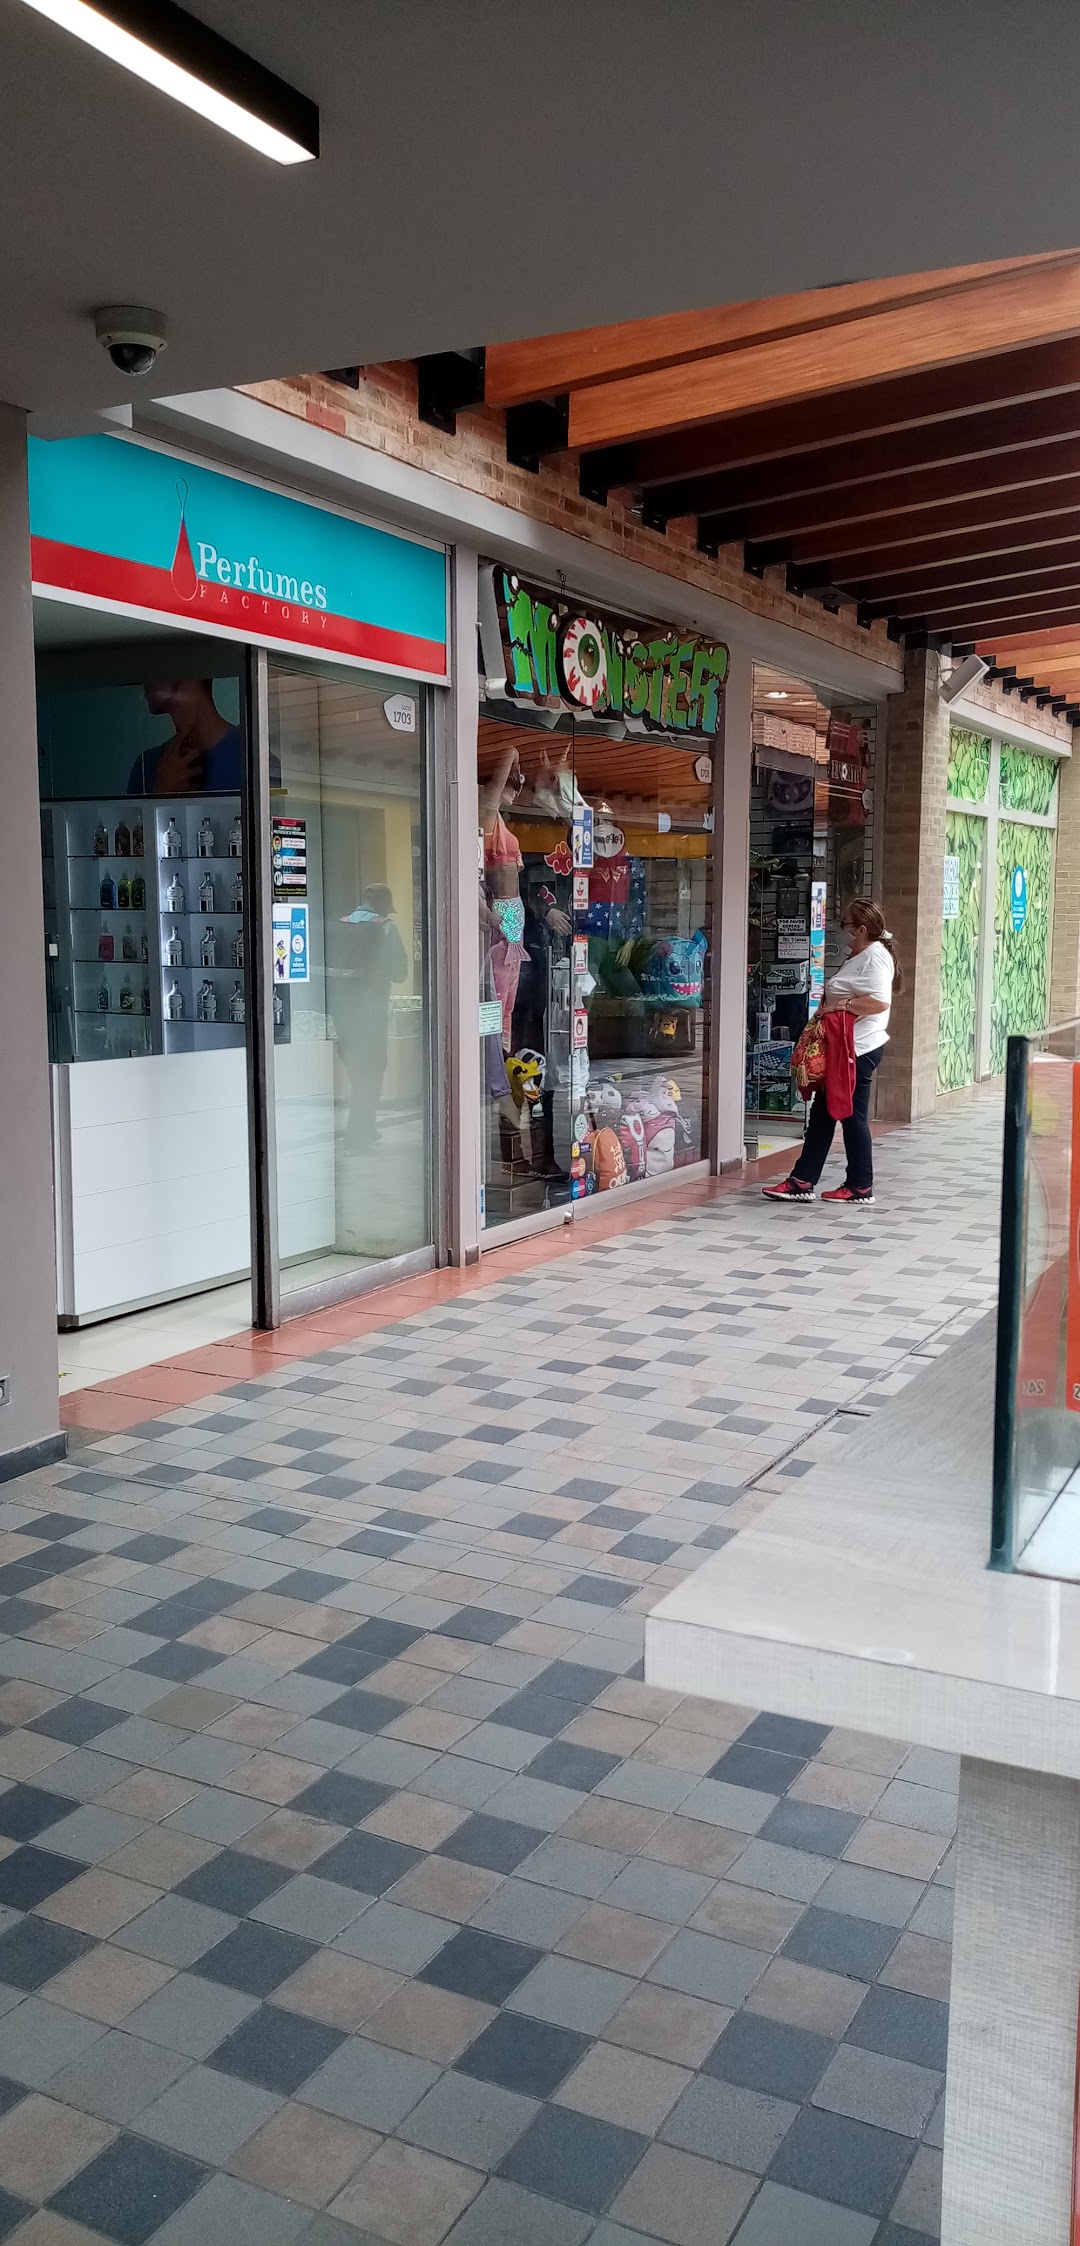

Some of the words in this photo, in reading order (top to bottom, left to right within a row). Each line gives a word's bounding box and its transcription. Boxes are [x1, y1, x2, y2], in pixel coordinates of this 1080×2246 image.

[197, 541, 327, 609] Perfumes
[502, 573, 728, 735] MONSTER
[393, 711, 412, 725] 1703
[294, 938, 302, 952] 5
